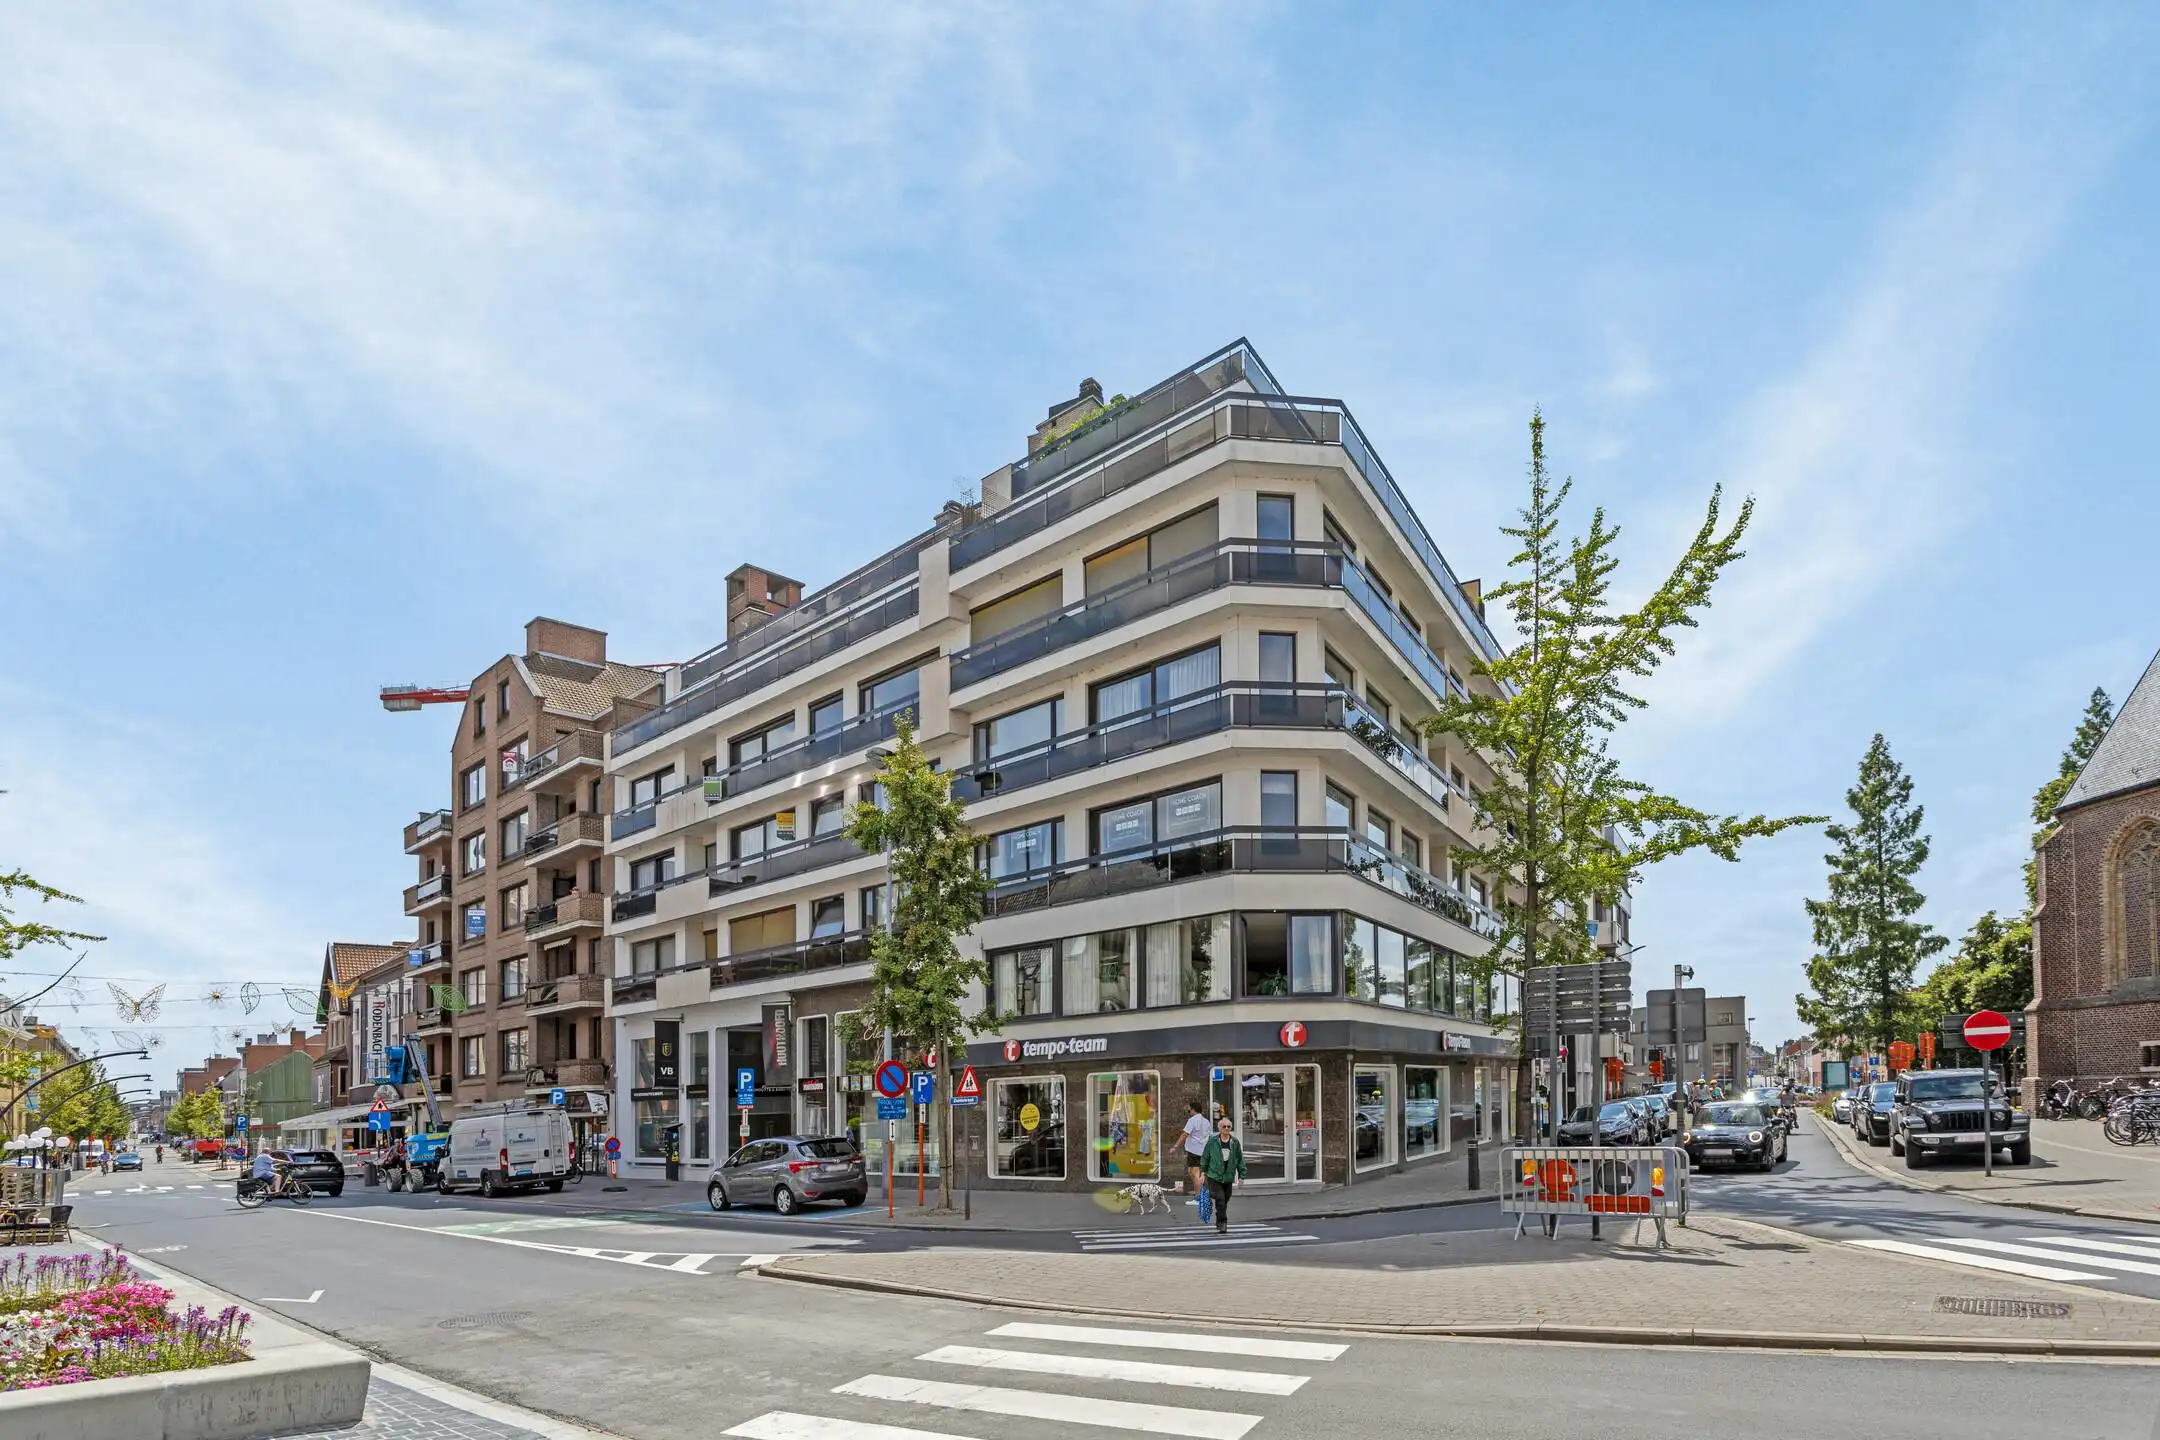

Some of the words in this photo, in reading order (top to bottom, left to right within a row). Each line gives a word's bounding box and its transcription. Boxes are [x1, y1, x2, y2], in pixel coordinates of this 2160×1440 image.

[372, 1001, 386, 1056] RODENBACH
[1022, 1037, 1108, 1060] tempo-team
[660, 1066, 674, 1075] VB
[740, 1072, 753, 1090] P
[917, 1076, 928, 1092] P
[552, 1091, 563, 1105] P
[237, 1116, 246, 1126] P
